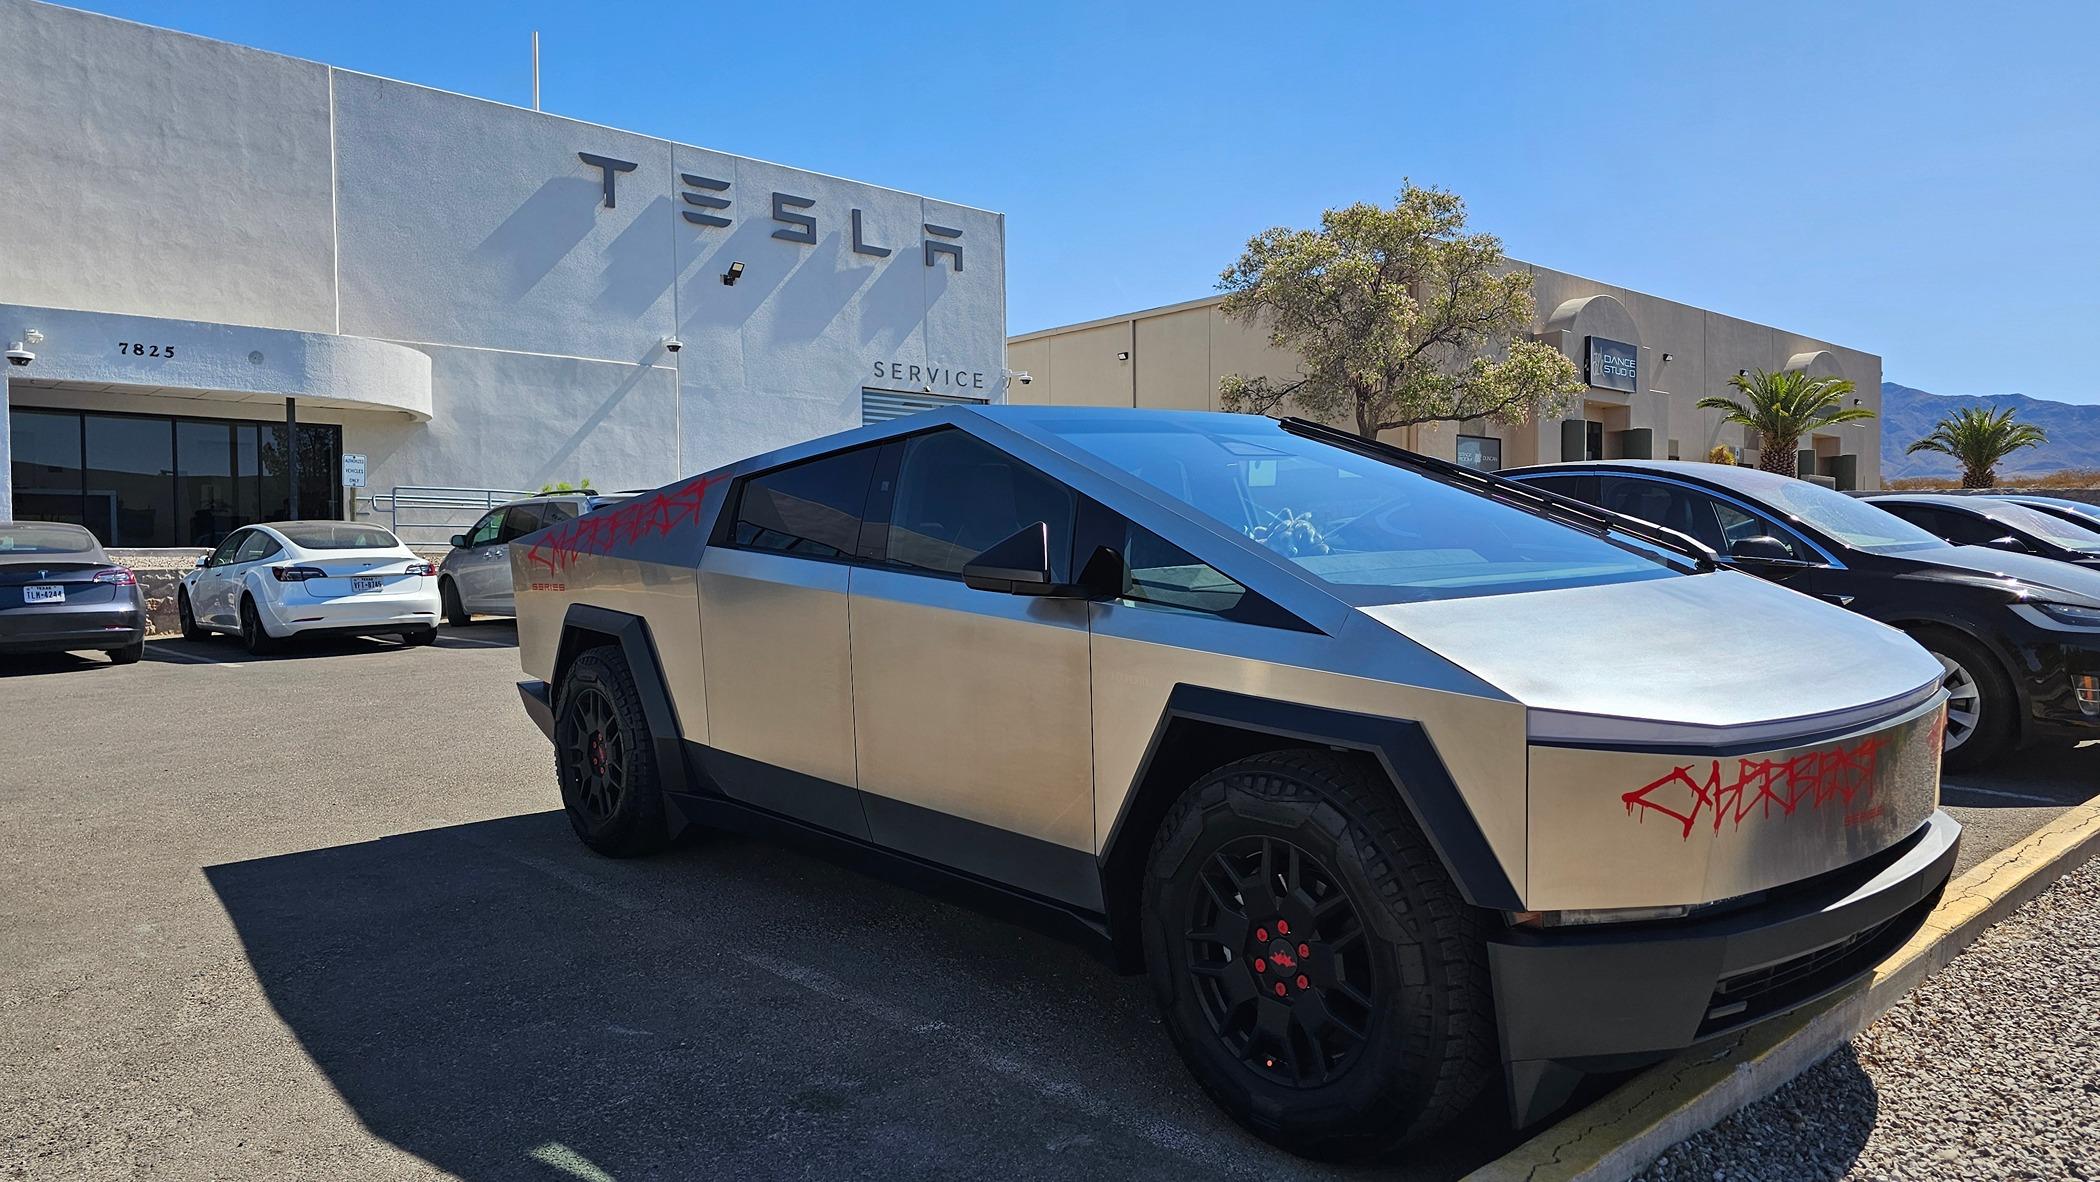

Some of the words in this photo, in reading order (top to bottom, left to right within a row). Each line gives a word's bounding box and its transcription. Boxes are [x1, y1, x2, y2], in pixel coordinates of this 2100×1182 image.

[578, 151, 963, 272] TESLA
[118, 342, 175, 359] 7825
[1603, 354, 1636, 369] DANCE
[873, 361, 984, 389] SERVICE
[1603, 365, 1636, 378] STUDO
[532, 583, 566, 591] SERIES
